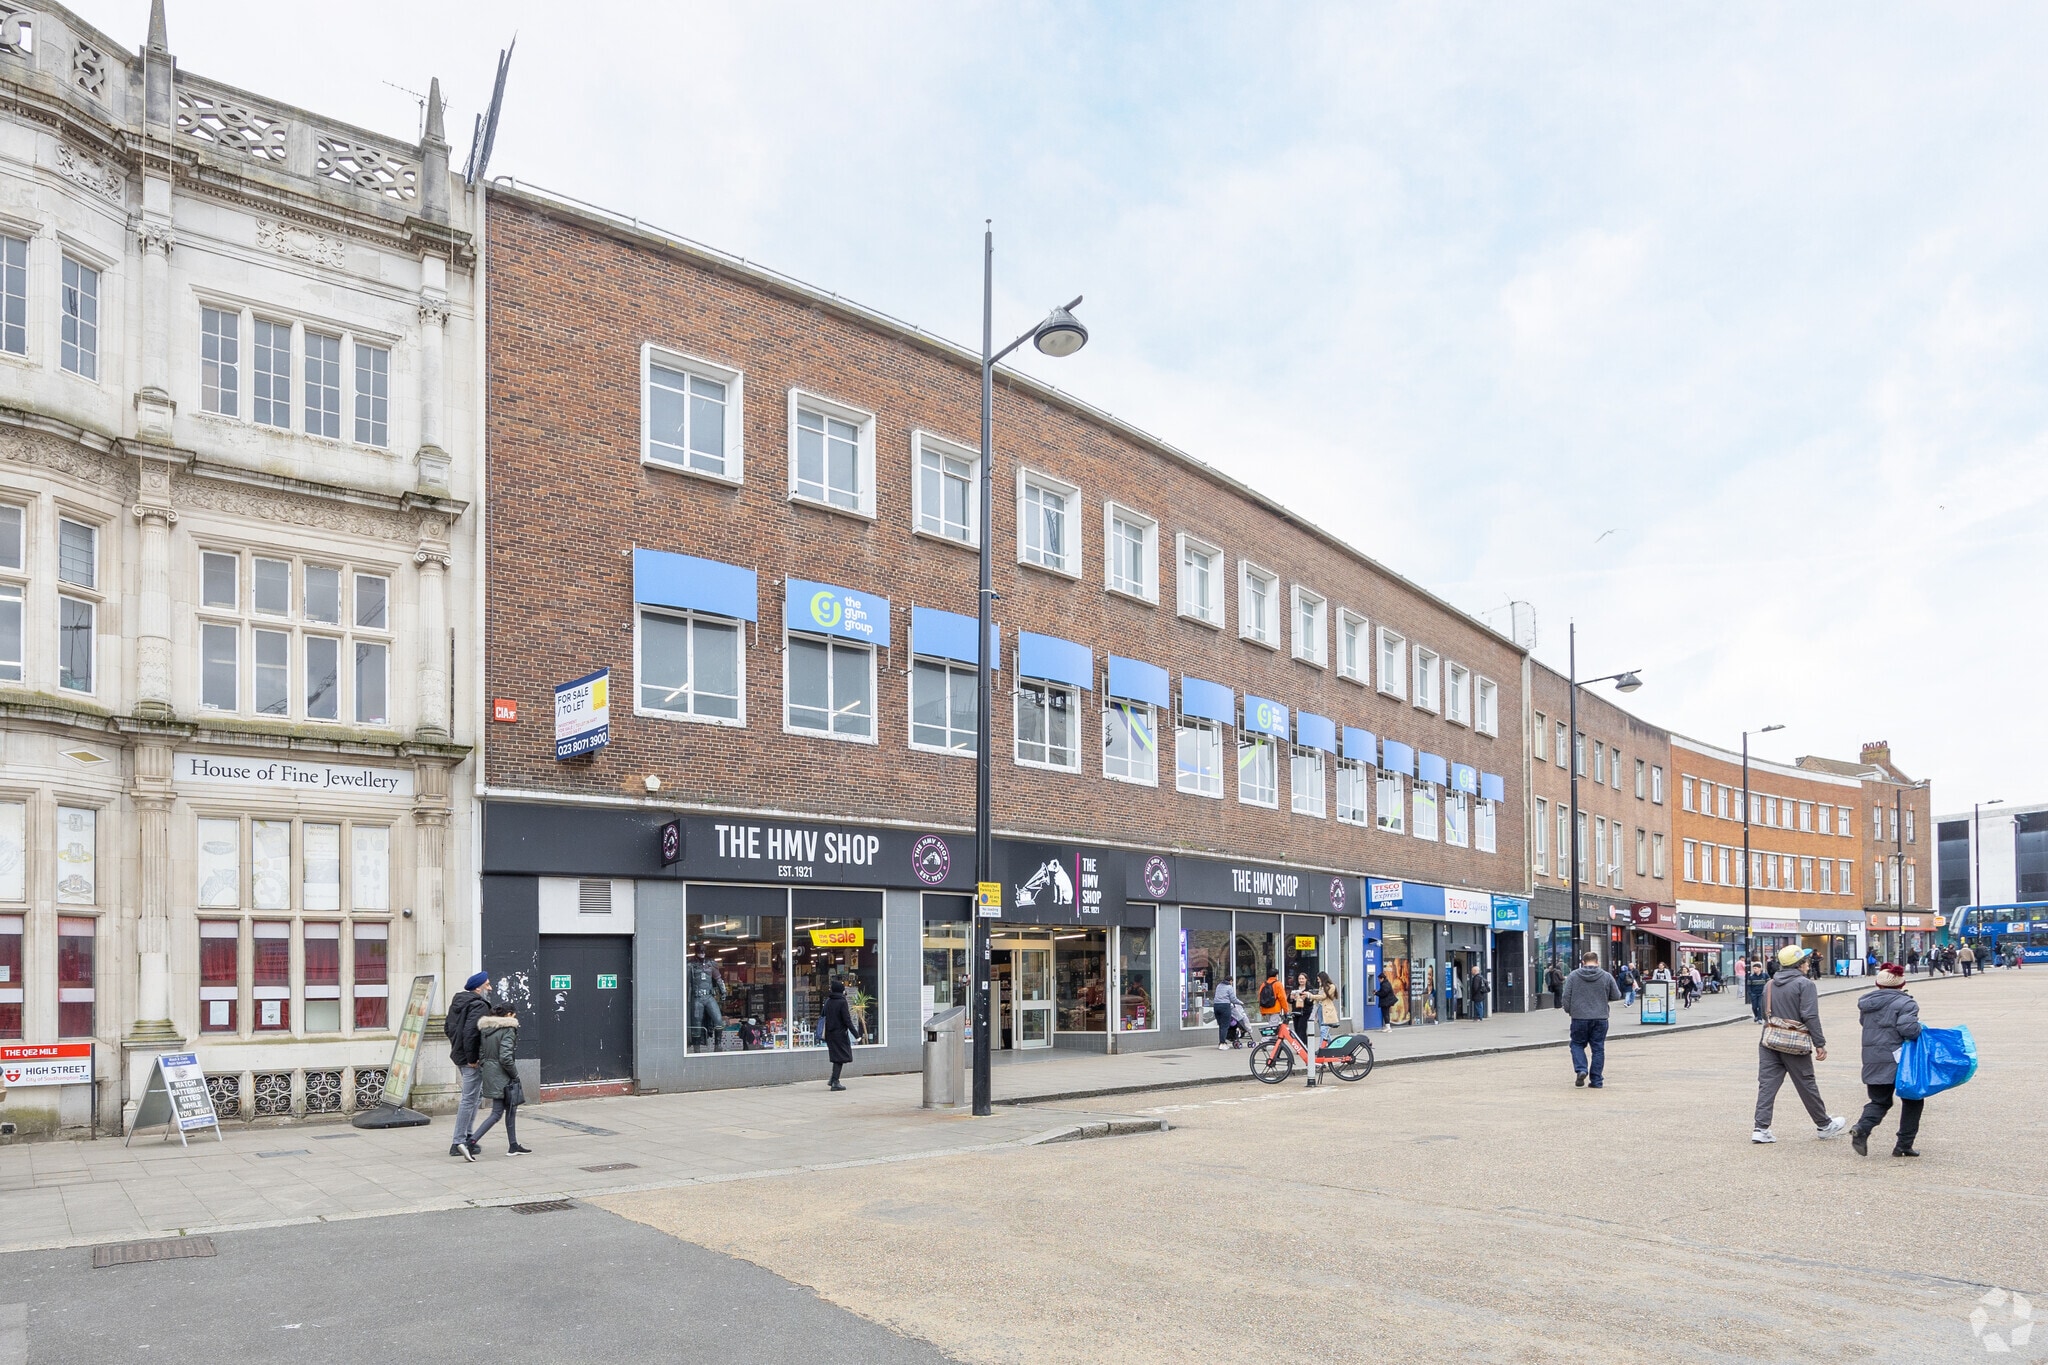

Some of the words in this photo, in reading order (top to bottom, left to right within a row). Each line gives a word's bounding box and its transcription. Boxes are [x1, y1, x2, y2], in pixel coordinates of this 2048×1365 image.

[844, 596, 861, 609] the
[844, 608, 867, 620] gym
[844, 620, 873, 636] group
[558, 693, 571, 704] FOR
[573, 686, 588, 700] SALE
[496, 707, 509, 718] CIA
[563, 705, 572, 714] TO
[573, 700, 584, 711] LET
[558, 744, 572, 756] 023
[573, 738, 588, 752] 8071
[590, 732, 606, 747] 3900
[190, 758, 250, 779] House
[257, 764, 277, 781] of
[281, 765, 319, 784] Fine
[323, 768, 398, 793] Jewellery
[715, 824, 760, 859] THE
[767, 828, 818, 862] HMV
[824, 832, 880, 866] SHOP
[914, 844, 922, 858] THE
[922, 838, 936, 846] HMV
[937, 842, 948, 861] SHOP
[1082, 857, 1096, 872] THE
[778, 866, 794, 877] EST.
[795, 867, 813, 878] 1921
[1082, 874, 1098, 889] HMV
[1232, 869, 1252, 893] THE
[1253, 871, 1274, 895] HMV
[1276, 874, 1298, 897] SHOP
[1082, 890, 1102, 905] SHOP
[1449, 898, 1467, 910] TESCO
[1814, 923, 1840, 933] HEYTEA
[829, 930, 856, 943] sale
[22, 1049, 38, 1057] QE2
[26, 1067, 48, 1075] HIGH
[51, 1065, 86, 1074] STREET
[174, 1080, 197, 1088] WATCH
[171, 1086, 205, 1096] BATTERIES
[179, 1094, 201, 1102] FITTED
[182, 1101, 203, 1109] WHILE
[179, 1110, 192, 1118] YOU
[194, 1107, 210, 1115] WAIT
